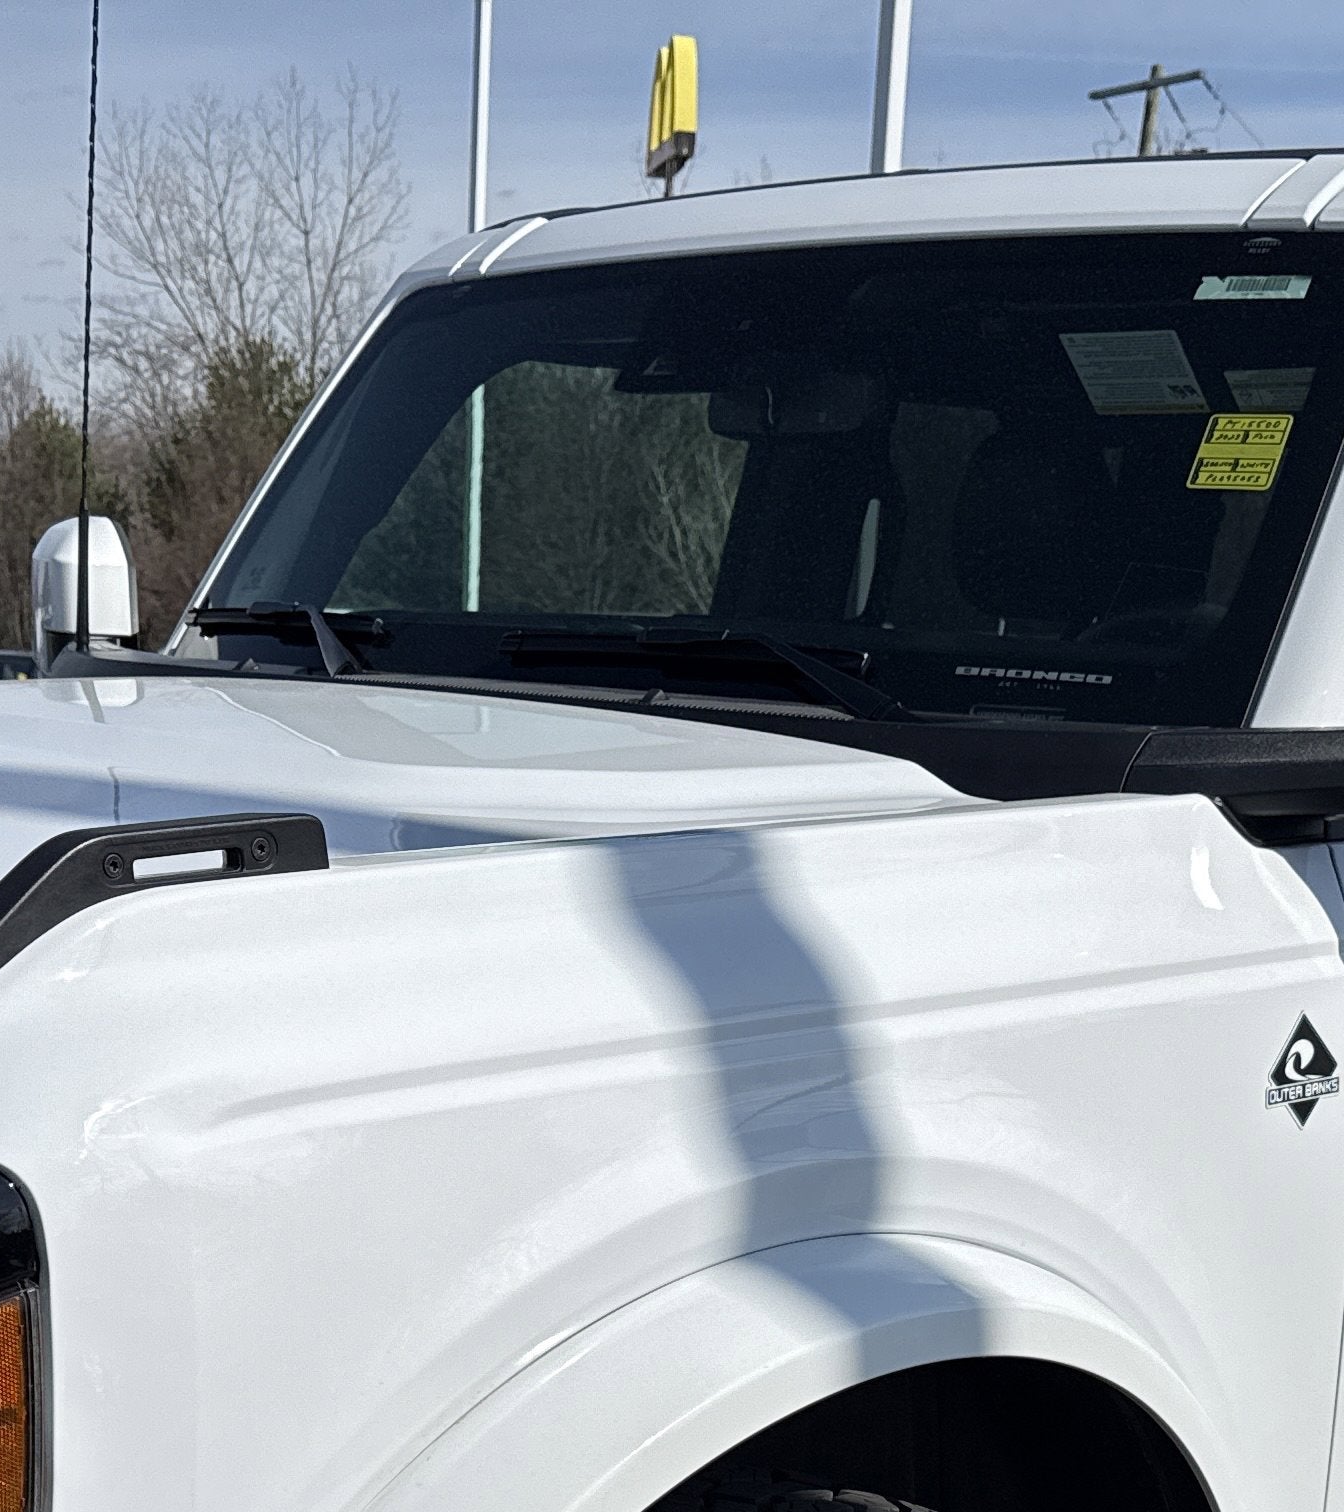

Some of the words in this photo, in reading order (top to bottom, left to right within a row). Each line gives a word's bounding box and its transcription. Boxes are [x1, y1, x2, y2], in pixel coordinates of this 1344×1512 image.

[954, 666, 1113, 684] BRONCO
[1269, 1085, 1304, 1104] OUTER
[1304, 1078, 1338, 1097] BANKS
